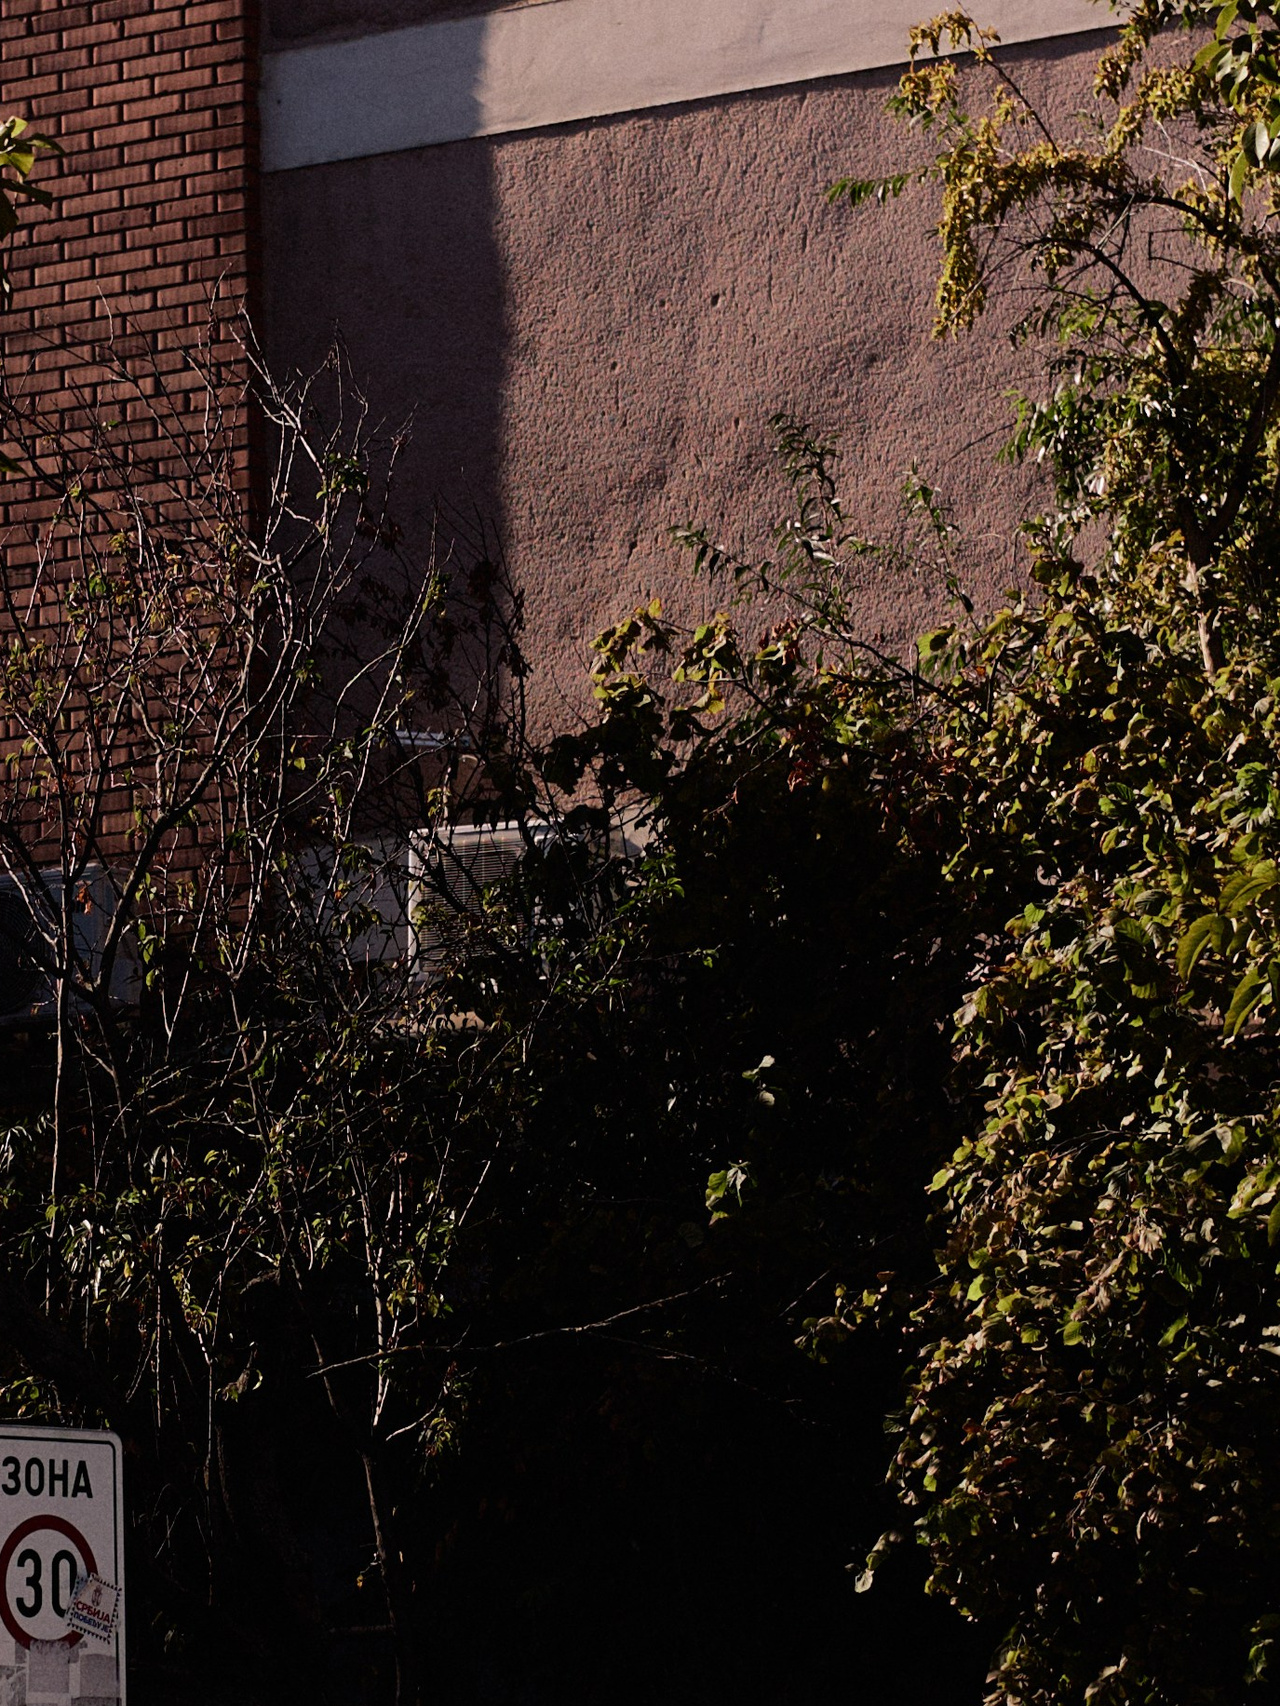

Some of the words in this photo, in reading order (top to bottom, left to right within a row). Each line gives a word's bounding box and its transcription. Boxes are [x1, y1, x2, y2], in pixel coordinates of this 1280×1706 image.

[1, 1455, 94, 1499] ЗОНА
[16, 1549, 78, 1618] 30
[76, 1601, 110, 1624] СРБИЈА
